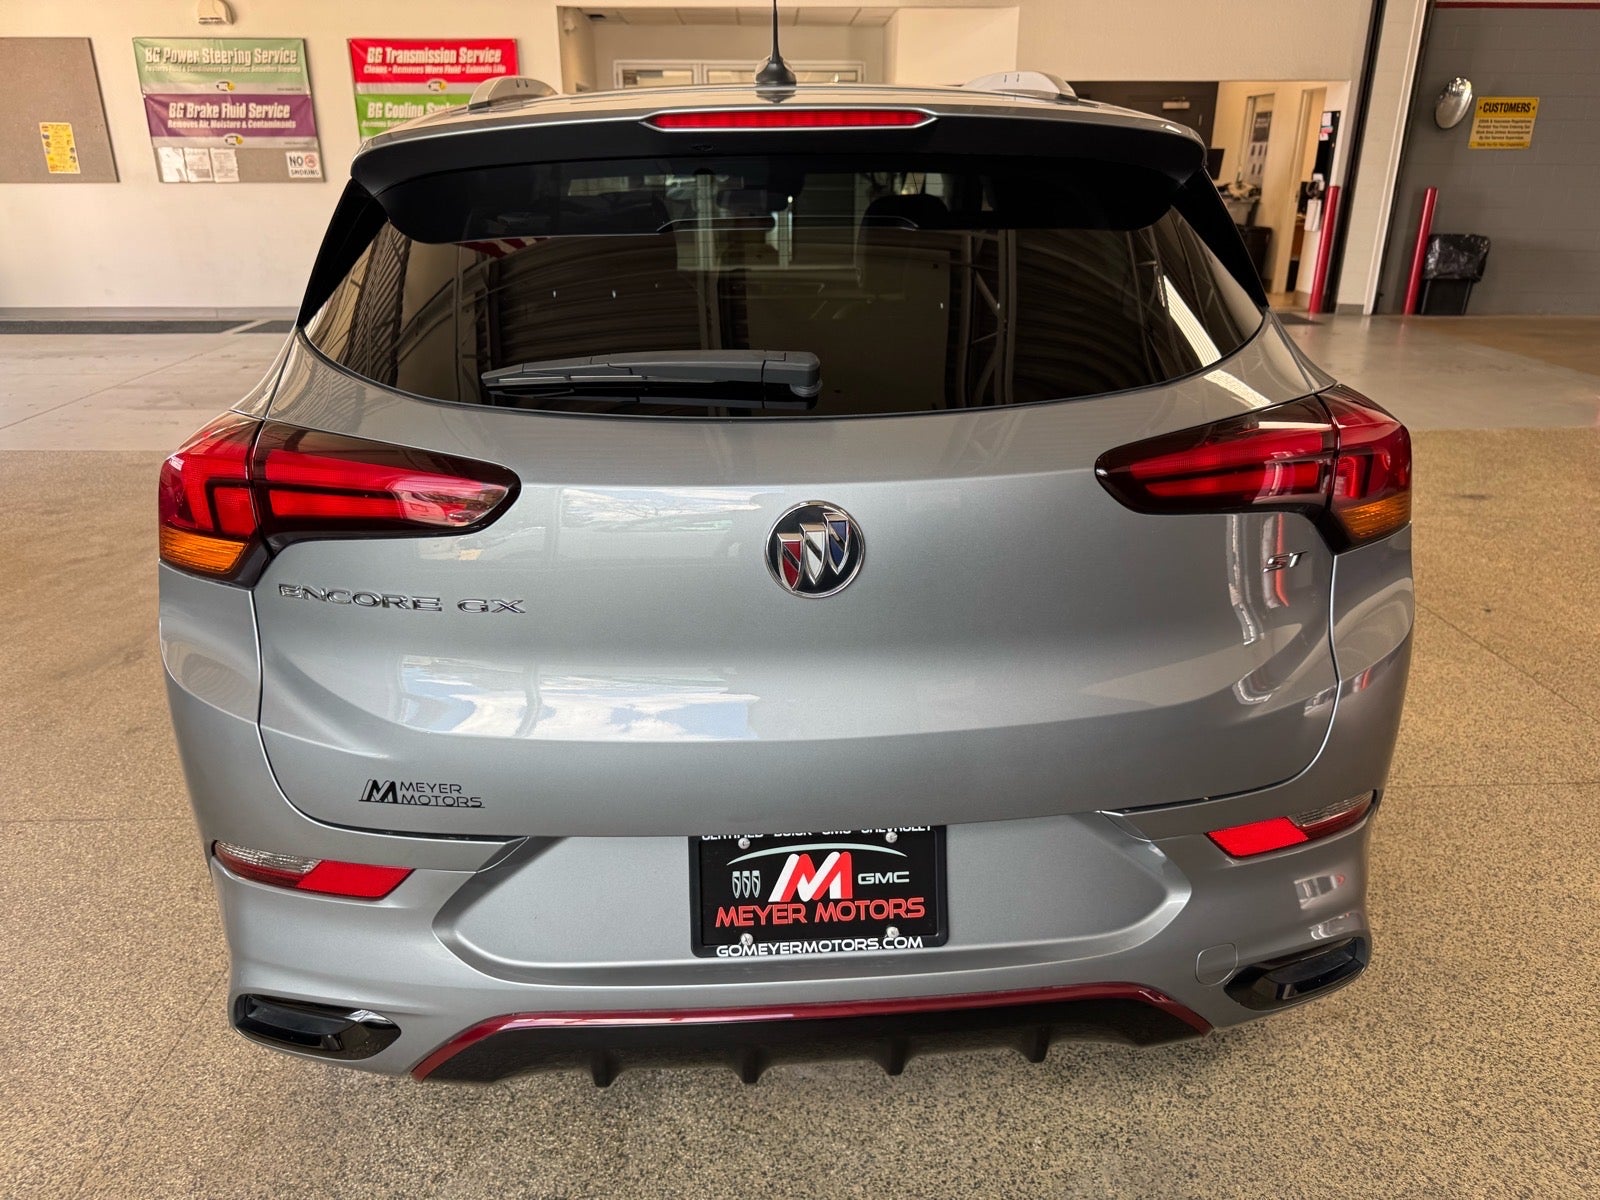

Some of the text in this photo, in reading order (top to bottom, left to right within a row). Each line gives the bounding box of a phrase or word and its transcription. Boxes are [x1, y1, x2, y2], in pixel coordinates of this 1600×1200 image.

[145, 47, 297, 66] BG Power Steering Service
[367, 47, 502, 63] BG Transmission Service
[168, 102, 290, 118] BG Brake Fluid Service
[367, 102, 384, 118] BG
[1482, 102, 1532, 113] CUSTOMERS
[167, 120, 198, 128] Removes
[289, 156, 303, 166] NO
[1263, 551, 1308, 573] ST
[278, 583, 526, 613] ENCORE GX
[400, 781, 462, 794] MEYER
[401, 794, 483, 808] MOTORS
[857, 871, 910, 885] GMC
[715, 897, 925, 927] MEYER MOTORS
[716, 936, 924, 957] GOMEYERMOTORS.COM
